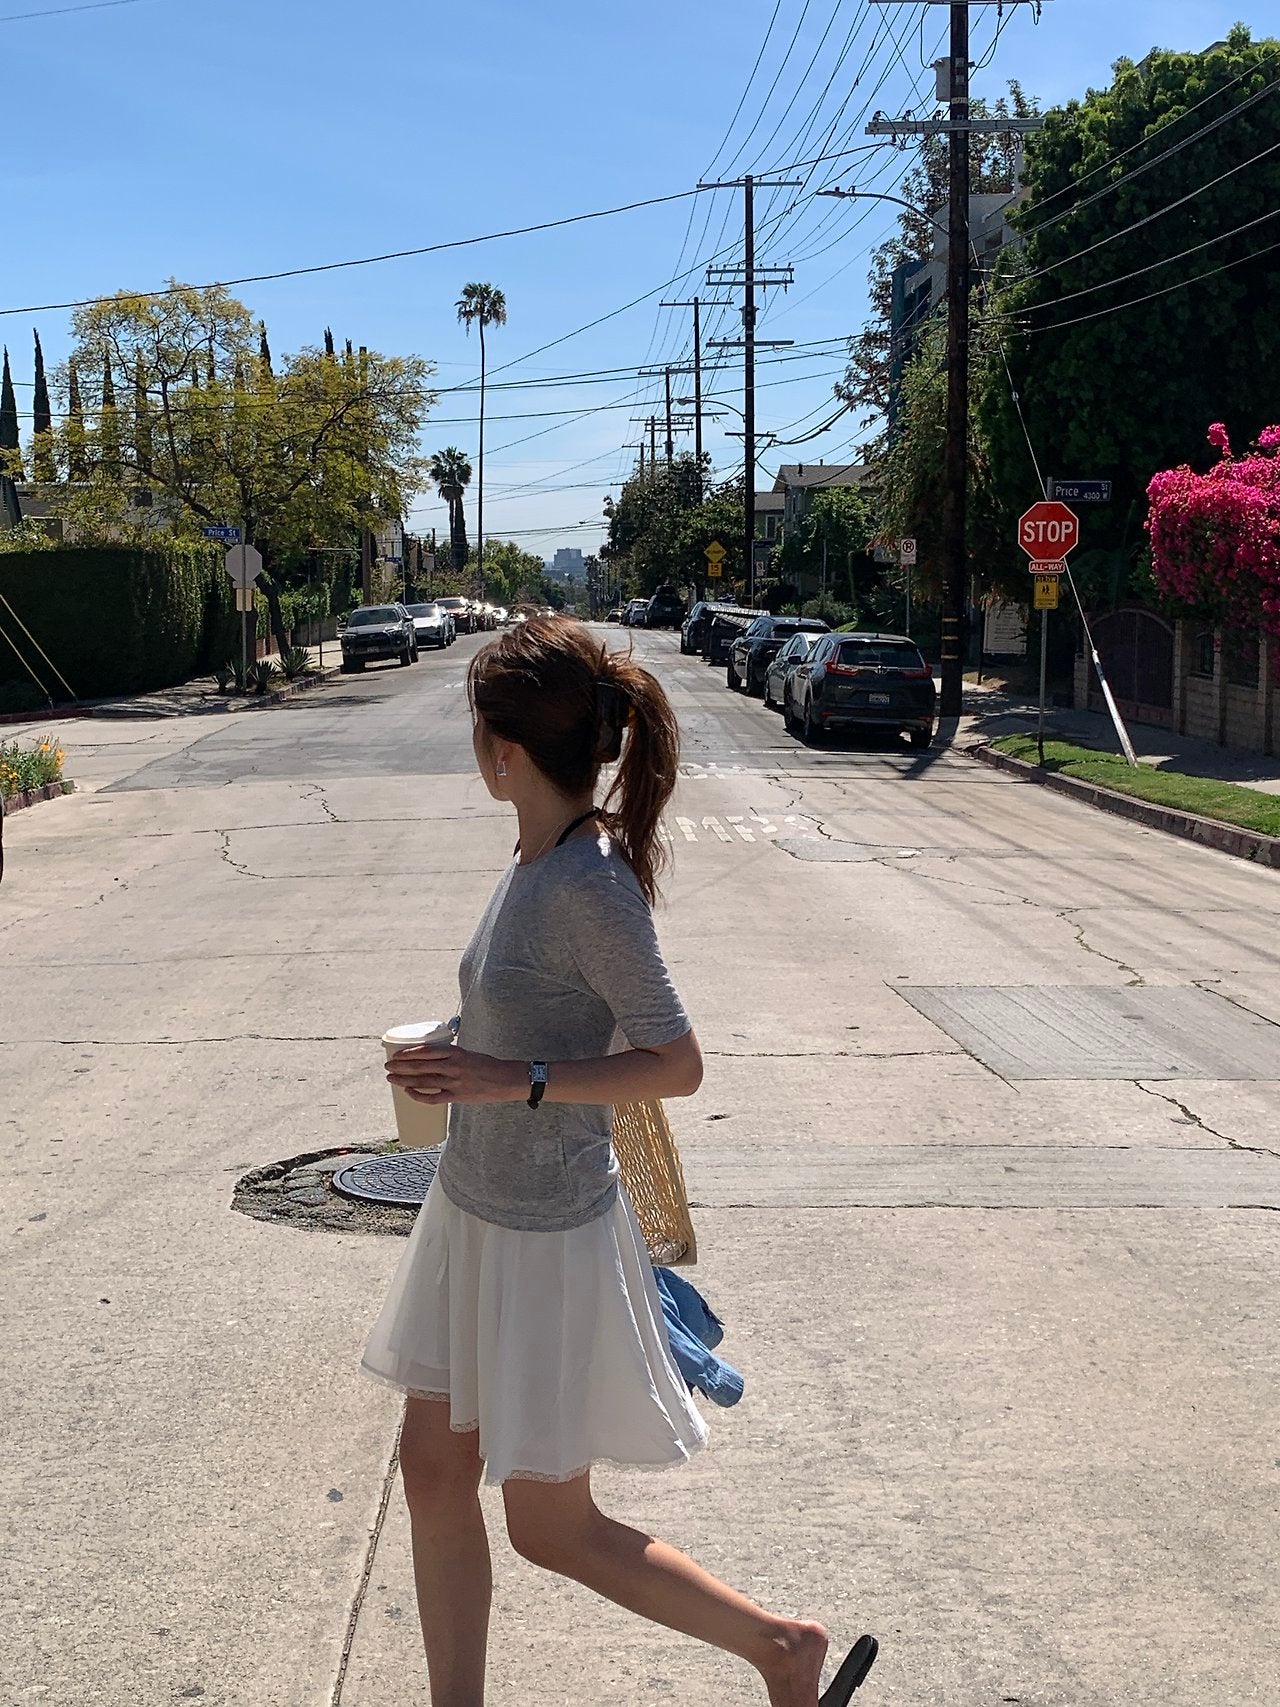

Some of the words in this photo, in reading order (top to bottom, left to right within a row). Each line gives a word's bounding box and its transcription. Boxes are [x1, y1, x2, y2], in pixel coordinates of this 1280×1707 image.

[1055, 485, 1079, 497] Price
[1023, 520, 1074, 543] STOP
[711, 564, 720, 572] 15
[1031, 563, 1063, 571] ALL-WAY
